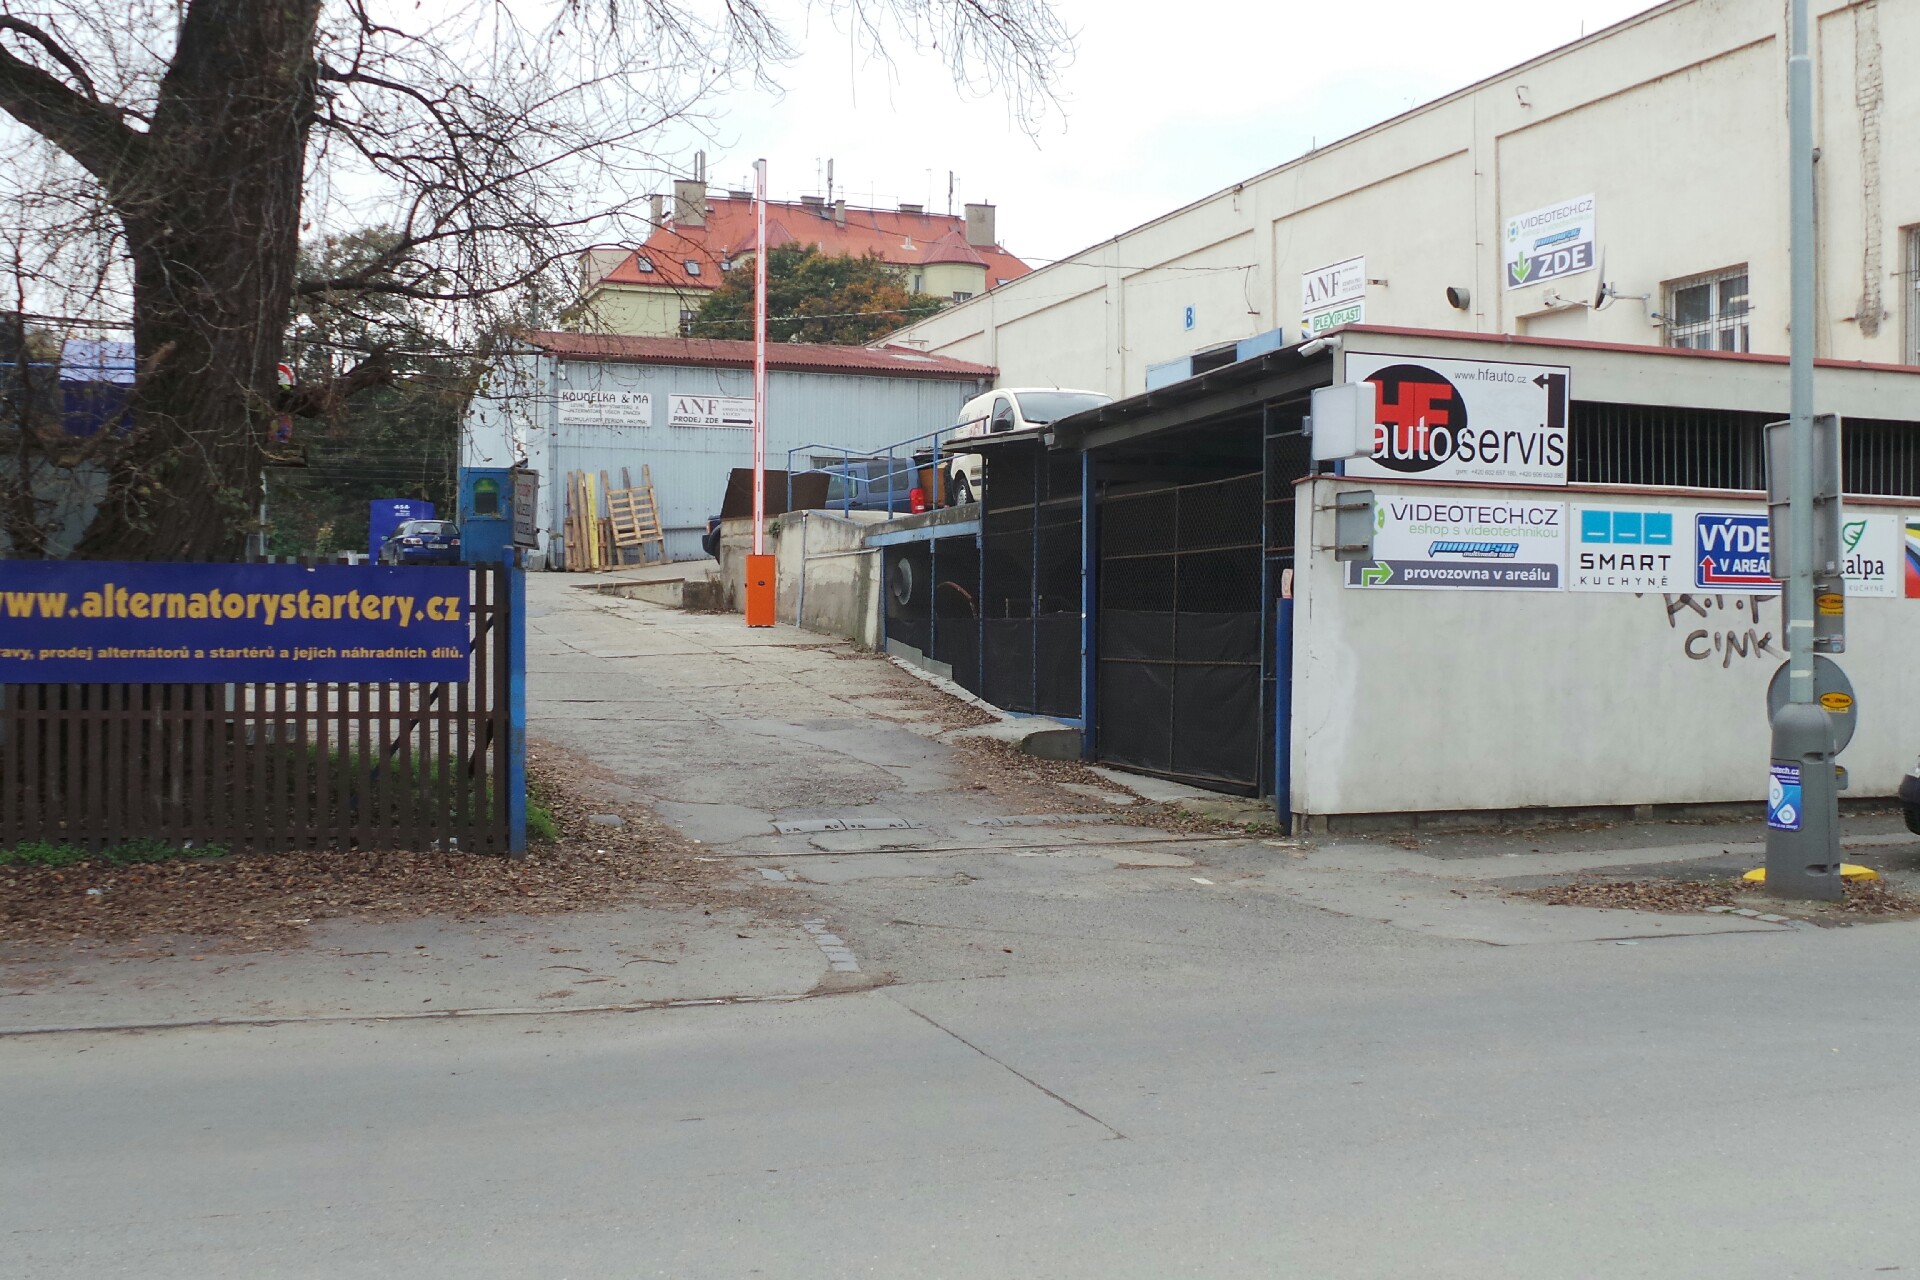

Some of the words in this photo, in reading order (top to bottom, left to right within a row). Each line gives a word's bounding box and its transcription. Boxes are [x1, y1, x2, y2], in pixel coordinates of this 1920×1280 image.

[1538, 244, 1586, 278] ZDE
[1304, 270, 1341, 305] ANF
[1186, 307, 1193, 328] B
[1313, 307, 1360, 331] PLEXIPLAST
[1454, 368, 1527, 384] www.hfauto.cz
[621, 393, 631, 404] &
[674, 397, 719, 416] ANF
[673, 415, 701, 424] PRODEJ
[1373, 414, 1565, 467] autoservis
[1390, 503, 1559, 526] VIDEOTECH.CZ
[1408, 523, 1449, 537] eshop
[1453, 526, 1460, 535] s
[1464, 524, 1559, 538] videotechnikou
[1699, 518, 1769, 553] VÝDE
[1580, 553, 1671, 571] SMART
[1720, 559, 1730, 571] V
[1404, 566, 1489, 582] provozovna
[1494, 570, 1503, 580] v
[1505, 568, 1551, 581] areálu
[0, 582, 461, 628] ww.alternatorystartery.cz
[0, 648, 35, 660] avy,
[39, 646, 94, 661] prodej
[98, 645, 189, 659] alternátorů
[194, 649, 205, 658] a
[209, 645, 274, 658] startérů
[280, 649, 289, 658] a
[293, 646, 337, 660] jejich
[341, 646, 427, 658] náhradních
[432, 646, 464, 659] dílů.
[1684, 628, 1784, 669] CINK
